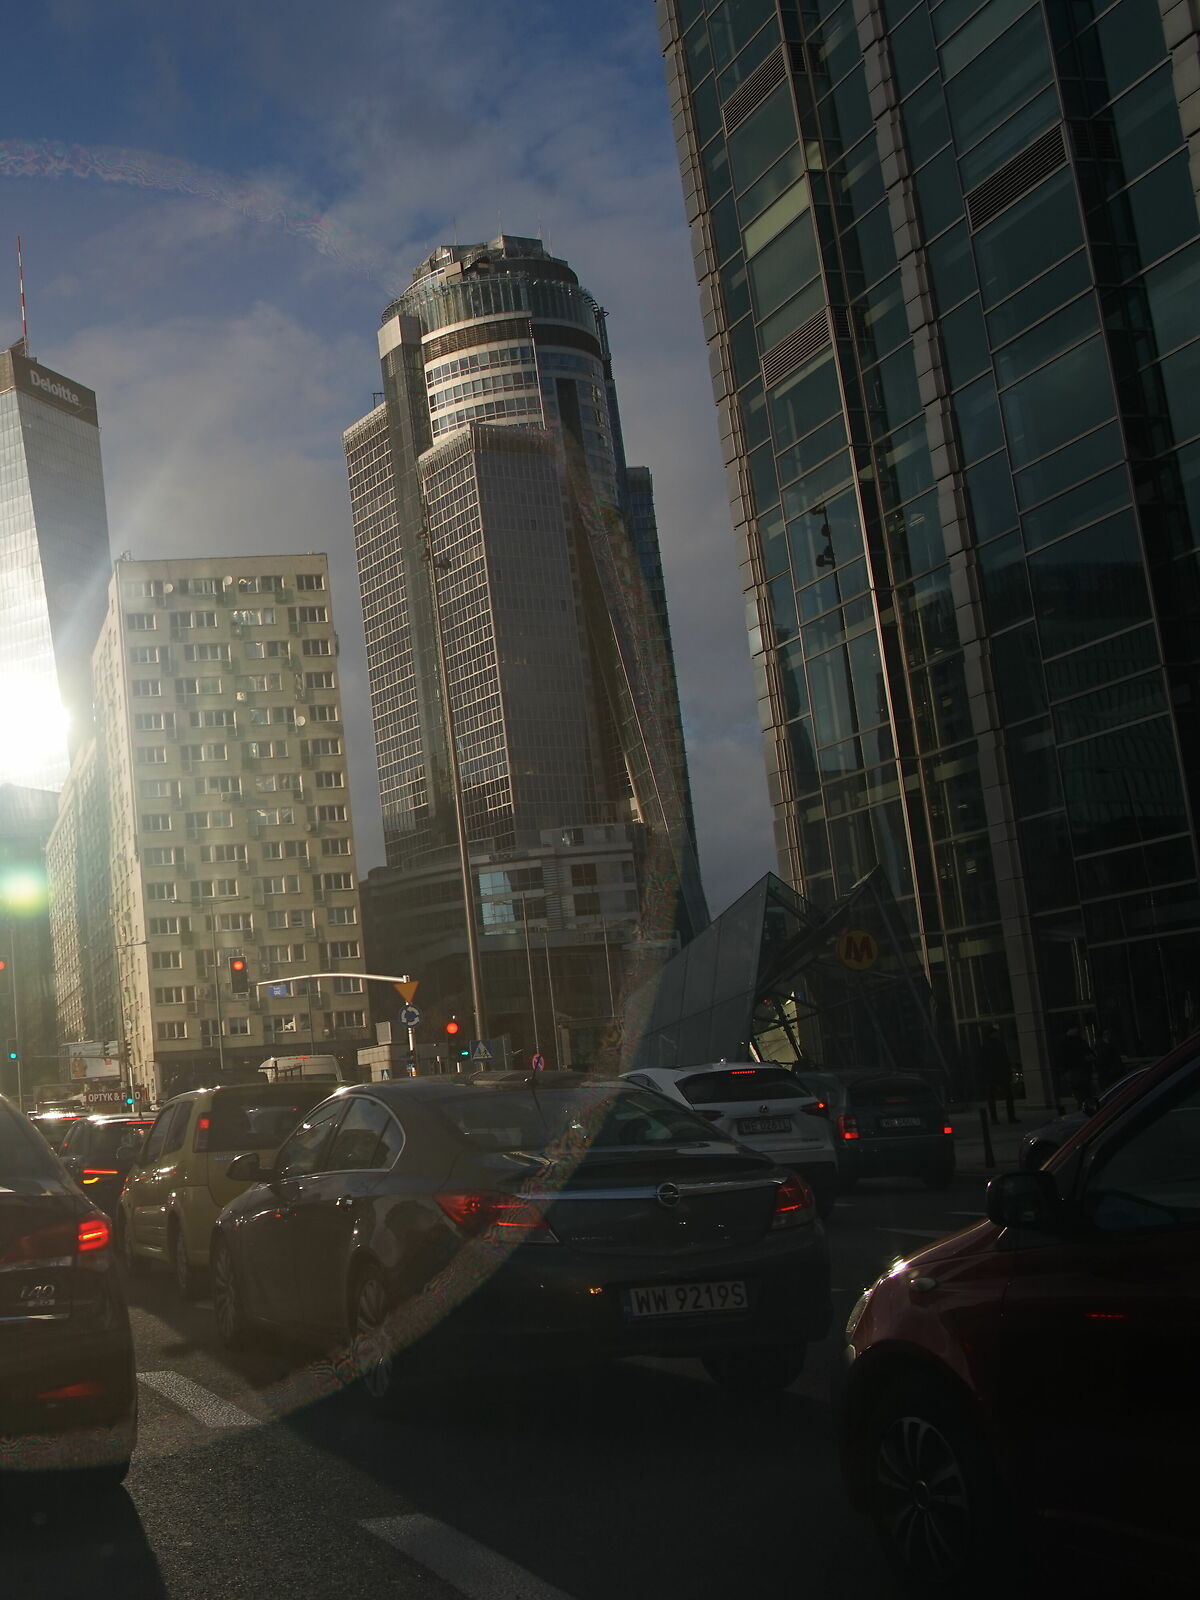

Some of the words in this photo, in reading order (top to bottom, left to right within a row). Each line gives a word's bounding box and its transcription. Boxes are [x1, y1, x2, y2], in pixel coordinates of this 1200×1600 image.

[845, 935, 873, 962] M
[88, 1092, 113, 1102] OPTYK
[634, 1288, 668, 1313] WW
[675, 1283, 745, 1310] 9219S
